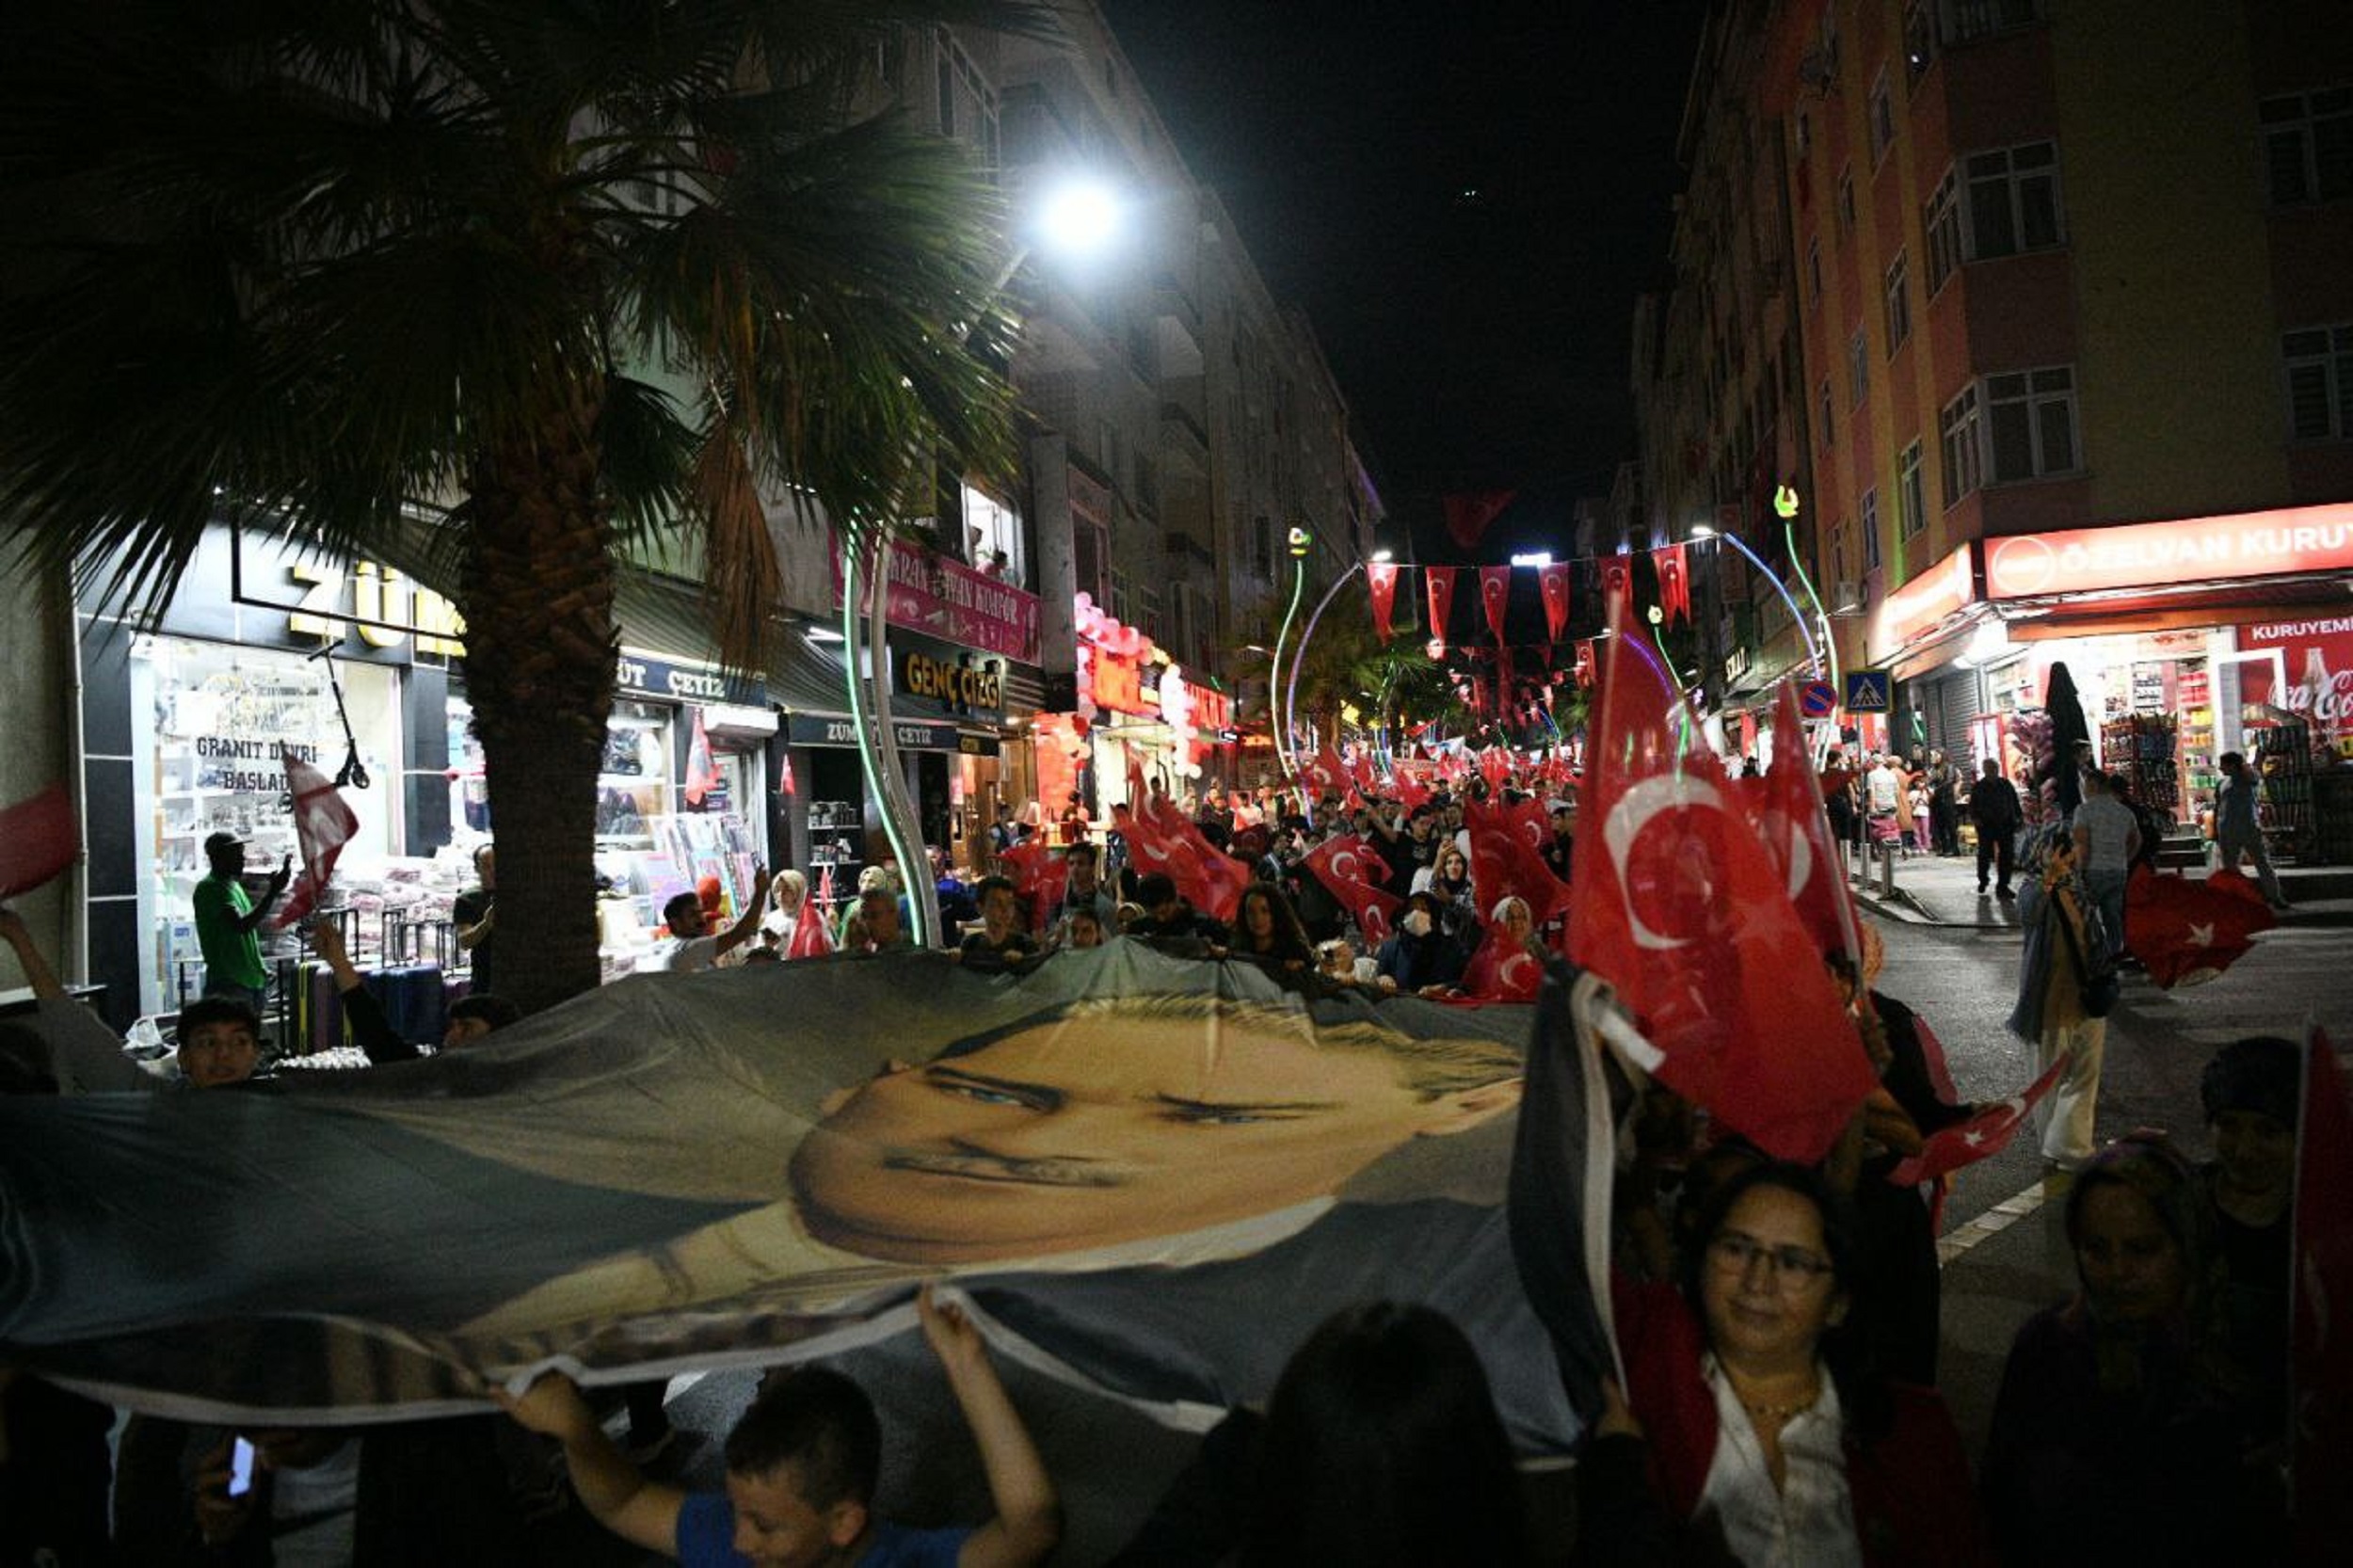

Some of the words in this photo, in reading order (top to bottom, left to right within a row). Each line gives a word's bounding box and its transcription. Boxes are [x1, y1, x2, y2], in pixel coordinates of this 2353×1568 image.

[2241, 523, 2353, 556] KURU
[290, 559, 468, 657] ZÜM
[906, 651, 956, 712] GENÇ
